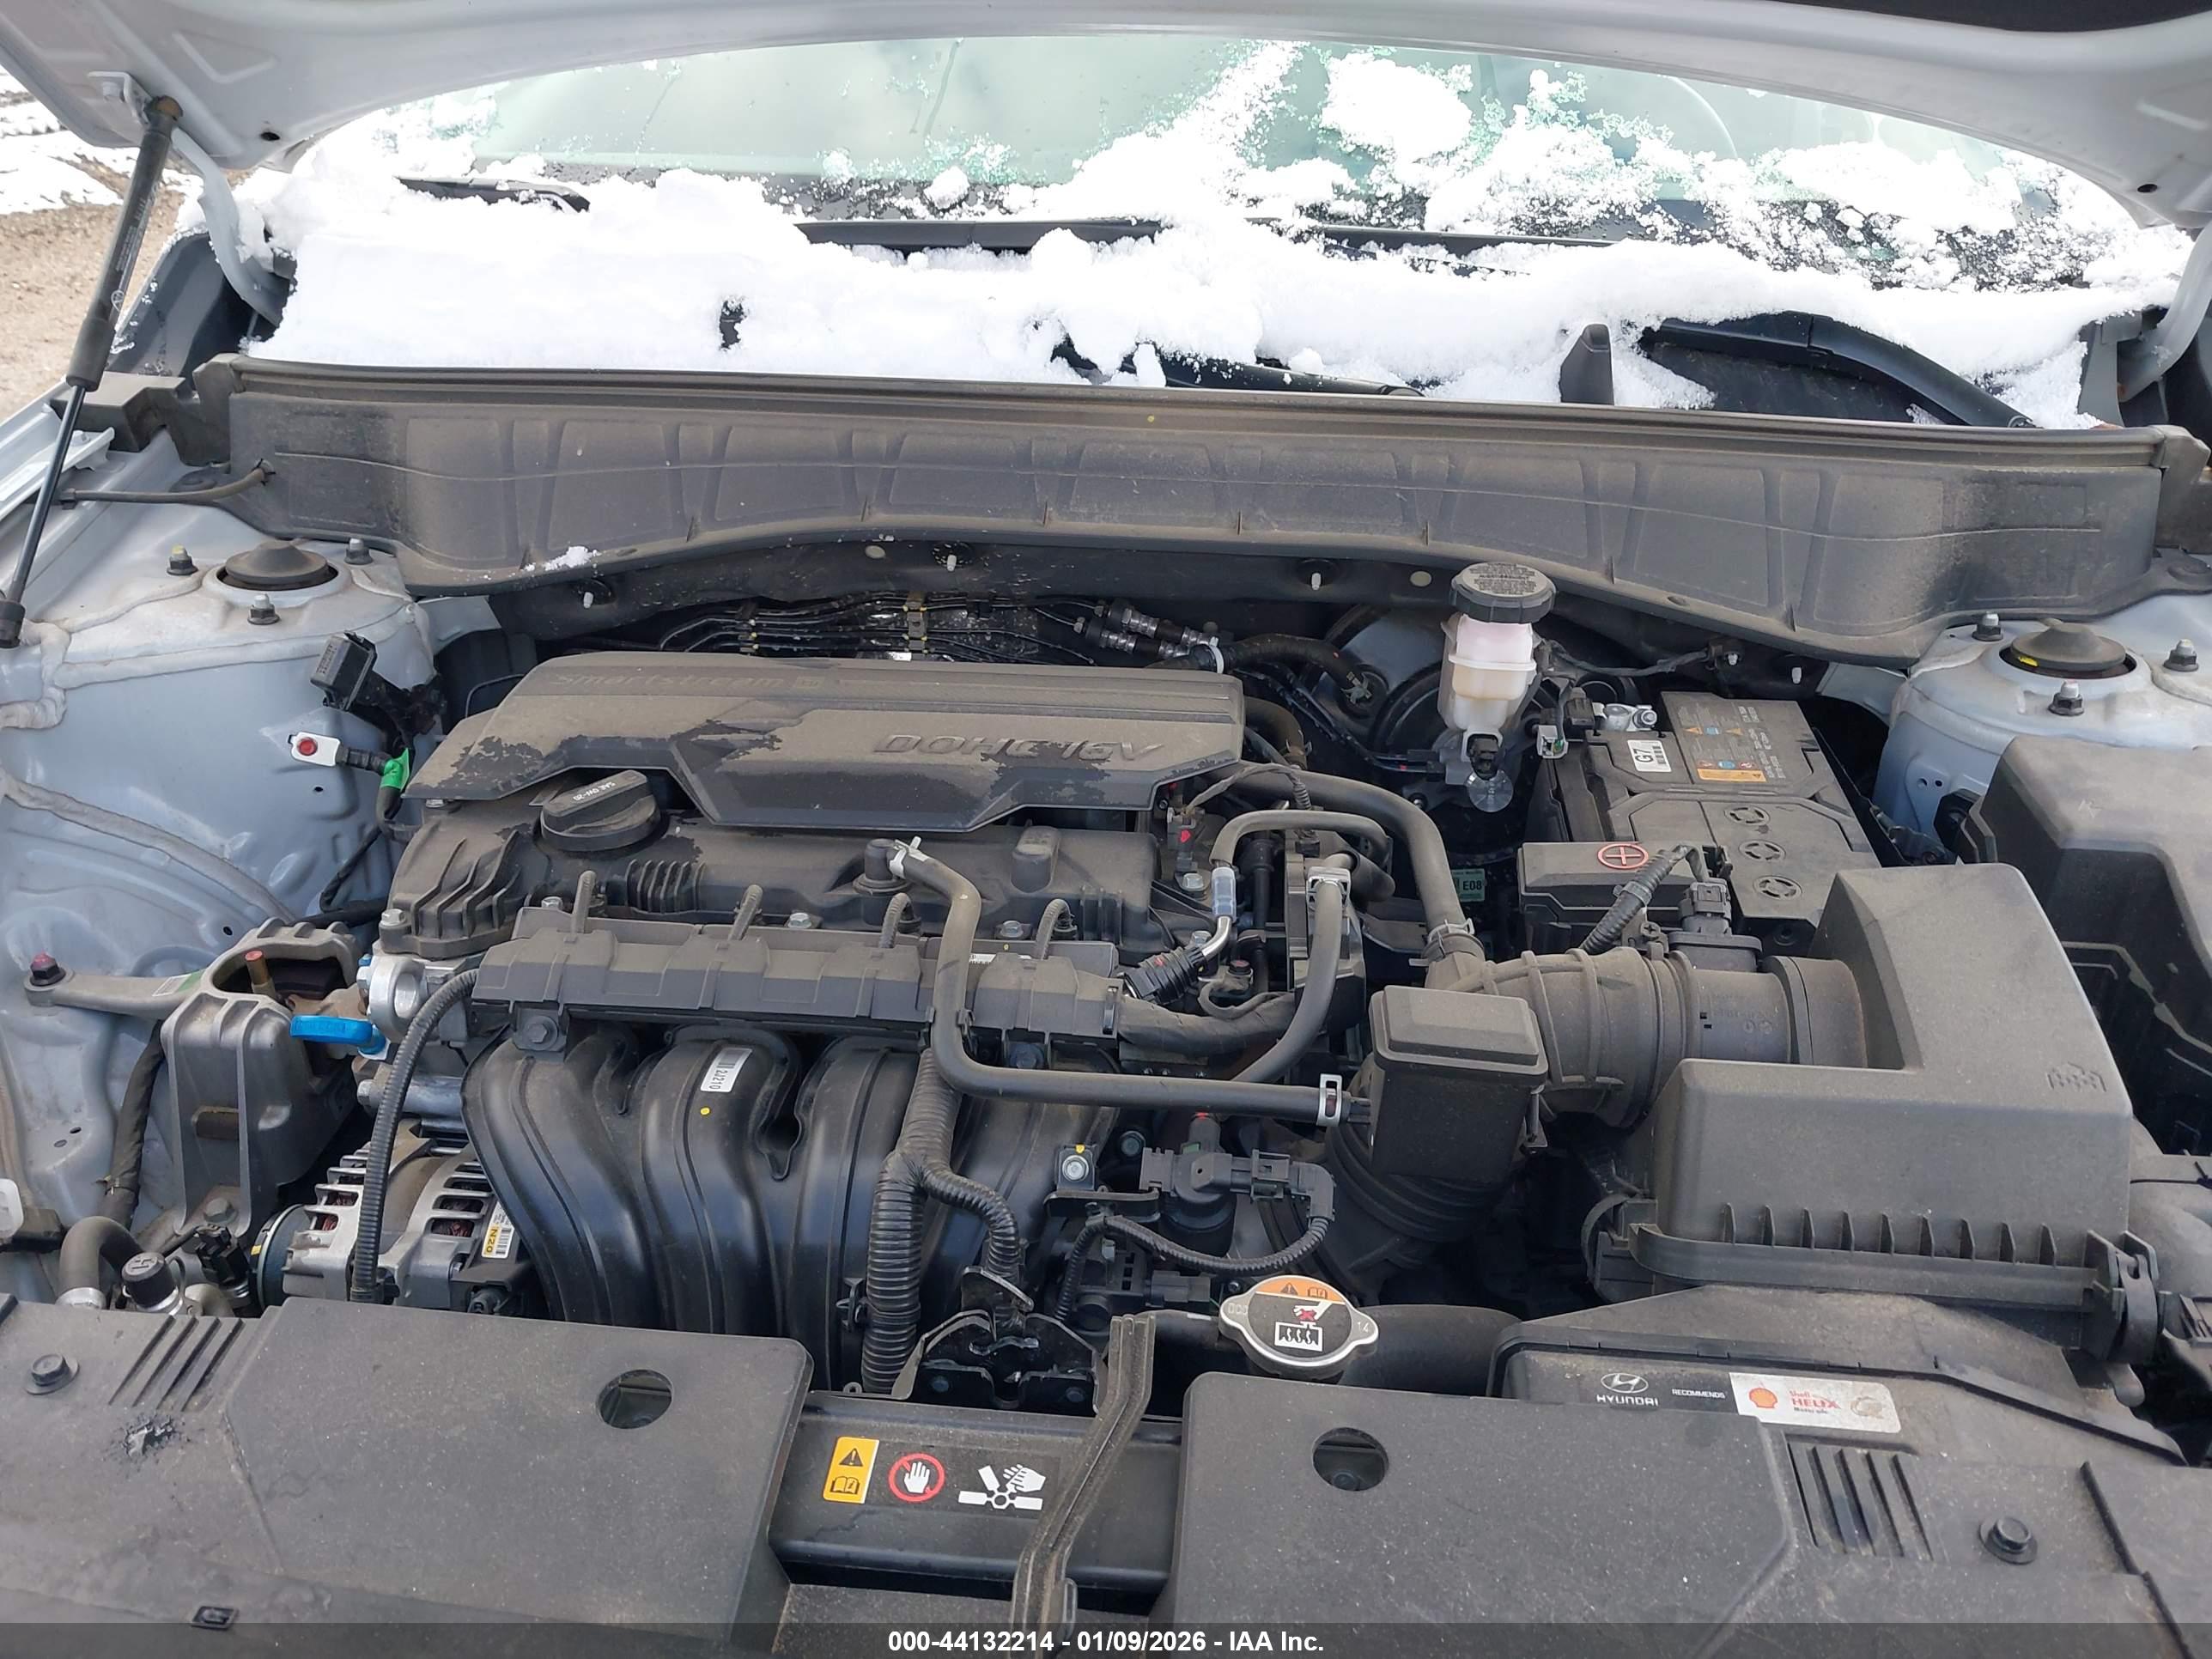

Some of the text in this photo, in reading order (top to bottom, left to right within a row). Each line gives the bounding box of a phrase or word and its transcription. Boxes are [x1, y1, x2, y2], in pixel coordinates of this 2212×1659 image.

[873, 734, 1164, 761] DOHC 16V
[1632, 748, 1654, 763] G7
[1462, 879, 1483, 891] E08
[1671, 1388, 1726, 1400] RECOMMENDS
[1596, 1394, 1660, 1407] HYUNDAI
[1791, 1397, 1841, 1409] HELIX
